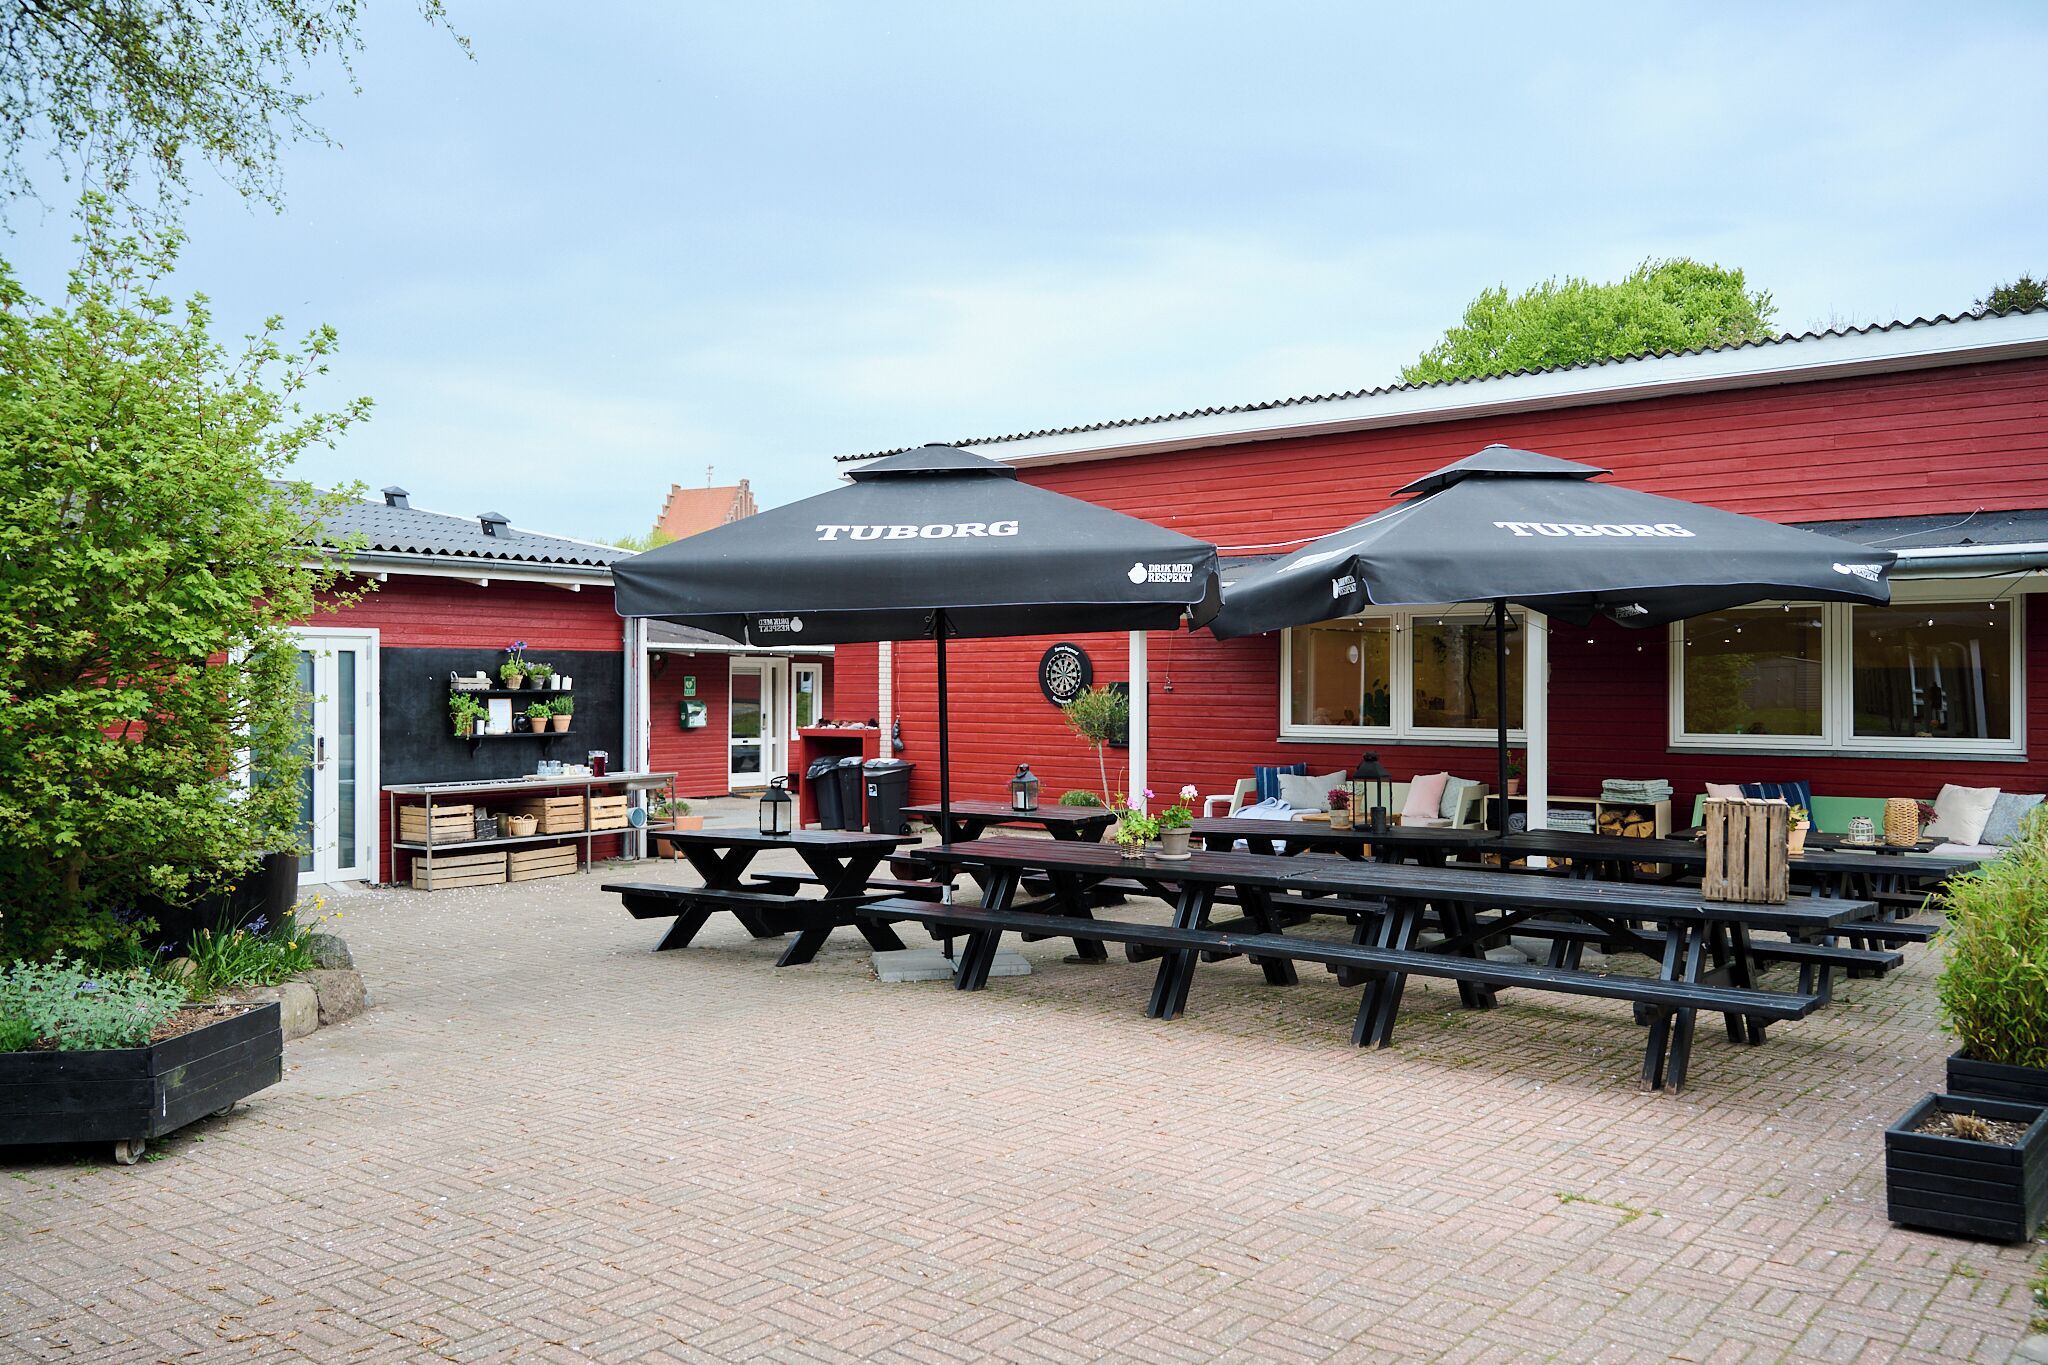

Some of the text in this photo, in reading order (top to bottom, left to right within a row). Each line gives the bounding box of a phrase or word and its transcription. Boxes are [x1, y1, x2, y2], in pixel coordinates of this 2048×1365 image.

[815, 520, 1019, 541] TUBORG
[1492, 521, 1697, 538] TUBORG
[1148, 564, 1193, 573] DRIK MED
[1148, 573, 1192, 583] RESPEKT
